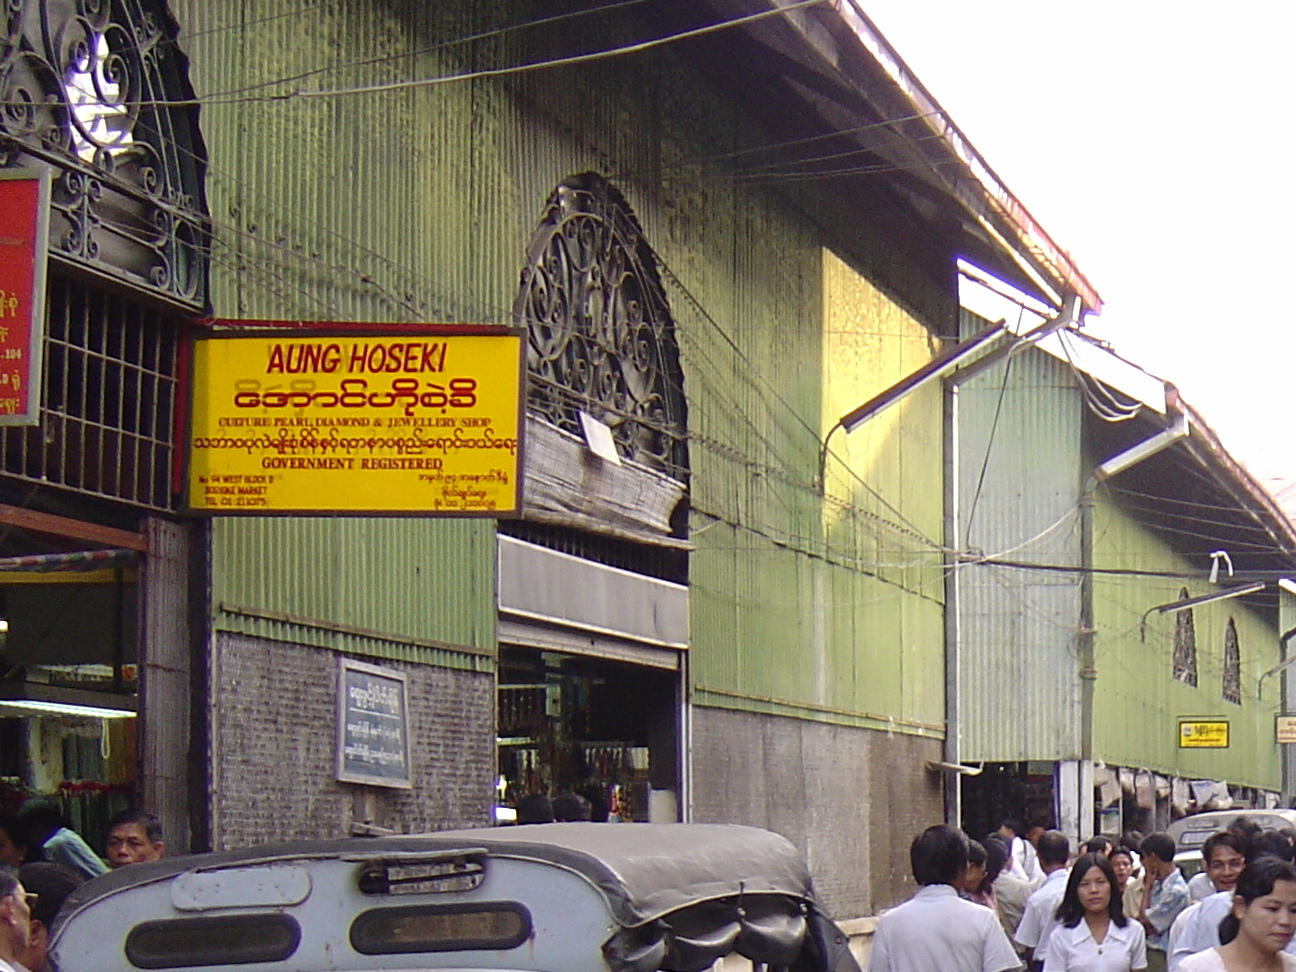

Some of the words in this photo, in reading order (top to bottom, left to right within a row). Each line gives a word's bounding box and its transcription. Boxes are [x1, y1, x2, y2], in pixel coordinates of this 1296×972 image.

[266, 342, 341, 374] AUNG
[348, 342, 448, 373] HOSEKI
[218, 416, 271, 429] CULTURE
[315, 416, 370, 428] DIAMOND
[373, 417, 382, 428] &
[387, 416, 458, 428] JEWELLERY
[461, 416, 492, 428] SHOP
[261, 457, 354, 471] GOVERNMENT
[361, 456, 443, 470] REGISTERED
[222, 475, 242, 484] WEST
[244, 475, 266, 484] BLOCK
[237, 486, 267, 495] MARKET
